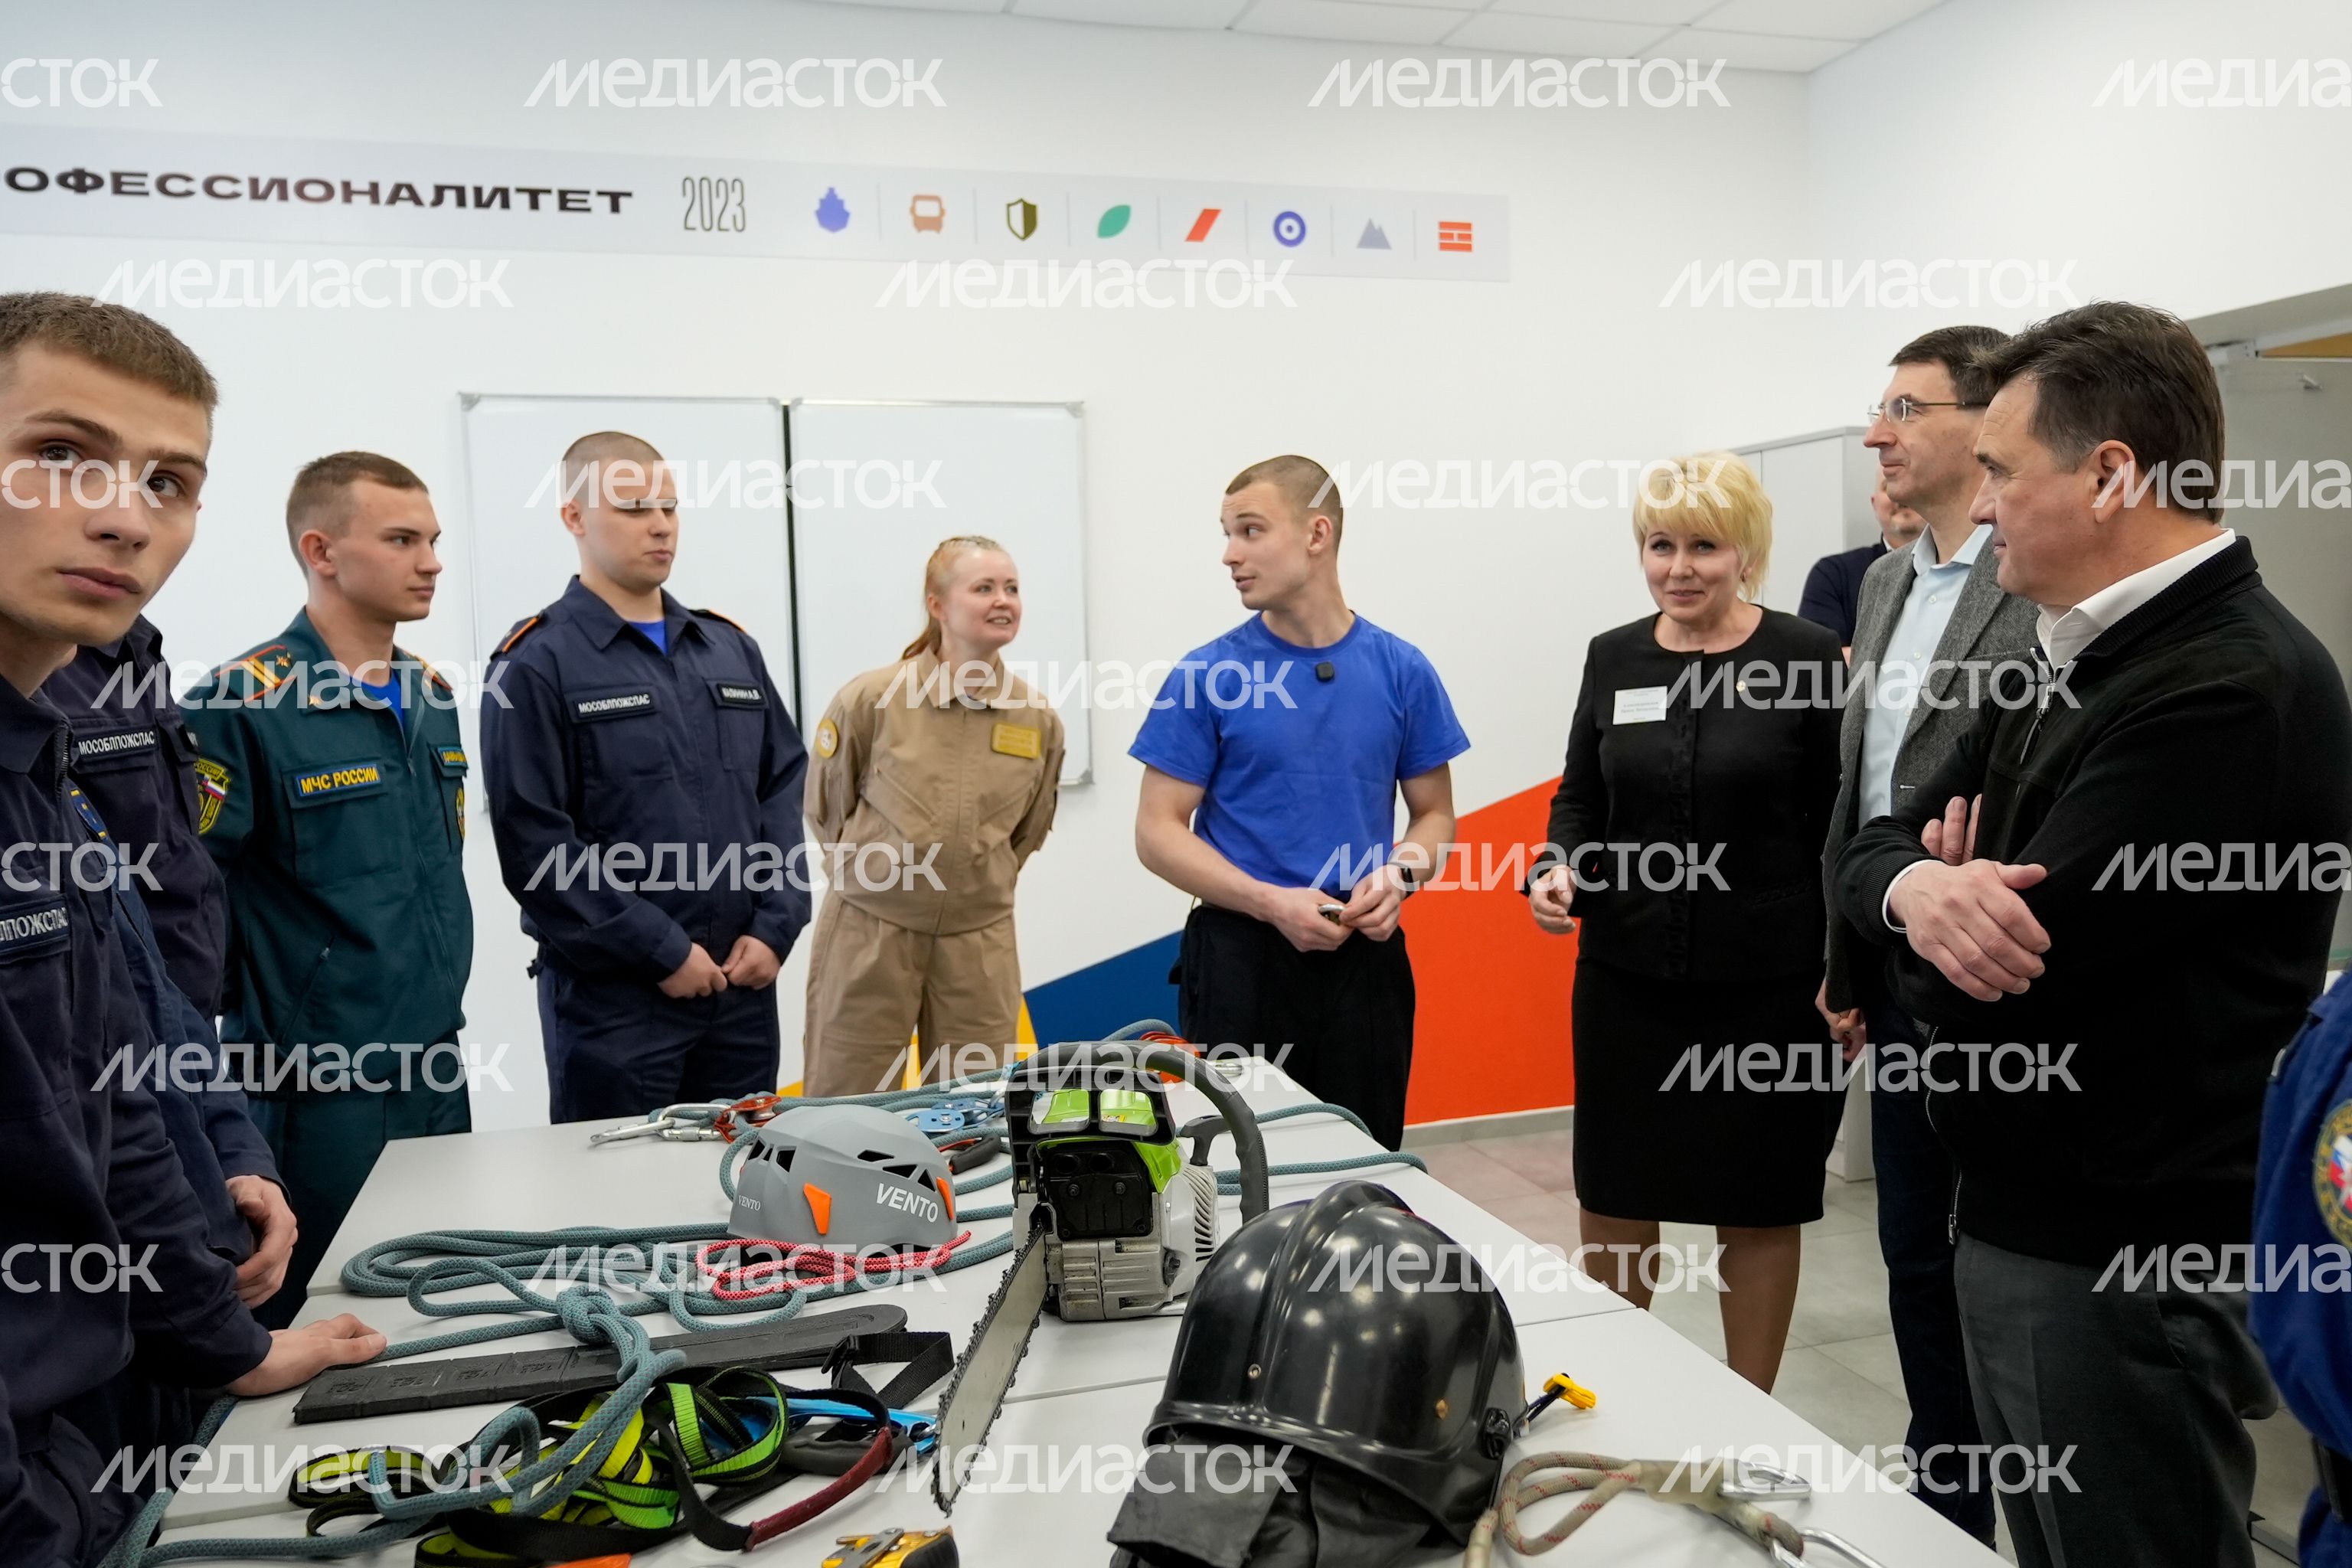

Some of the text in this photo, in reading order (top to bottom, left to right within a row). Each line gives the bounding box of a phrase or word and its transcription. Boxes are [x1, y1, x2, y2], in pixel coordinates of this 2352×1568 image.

[4, 166, 746, 233] ОФЕССИОНАЛИТЕТ 2023
[577, 694, 651, 713] МОСОБЛПОЖСПАС
[78, 731, 155, 755] МОСОБЛПОЖСПАС
[301, 766, 380, 794] МЧС РОССИИ
[737, 1194, 762, 1211] VENTO
[876, 1183, 939, 1223] VENTO
